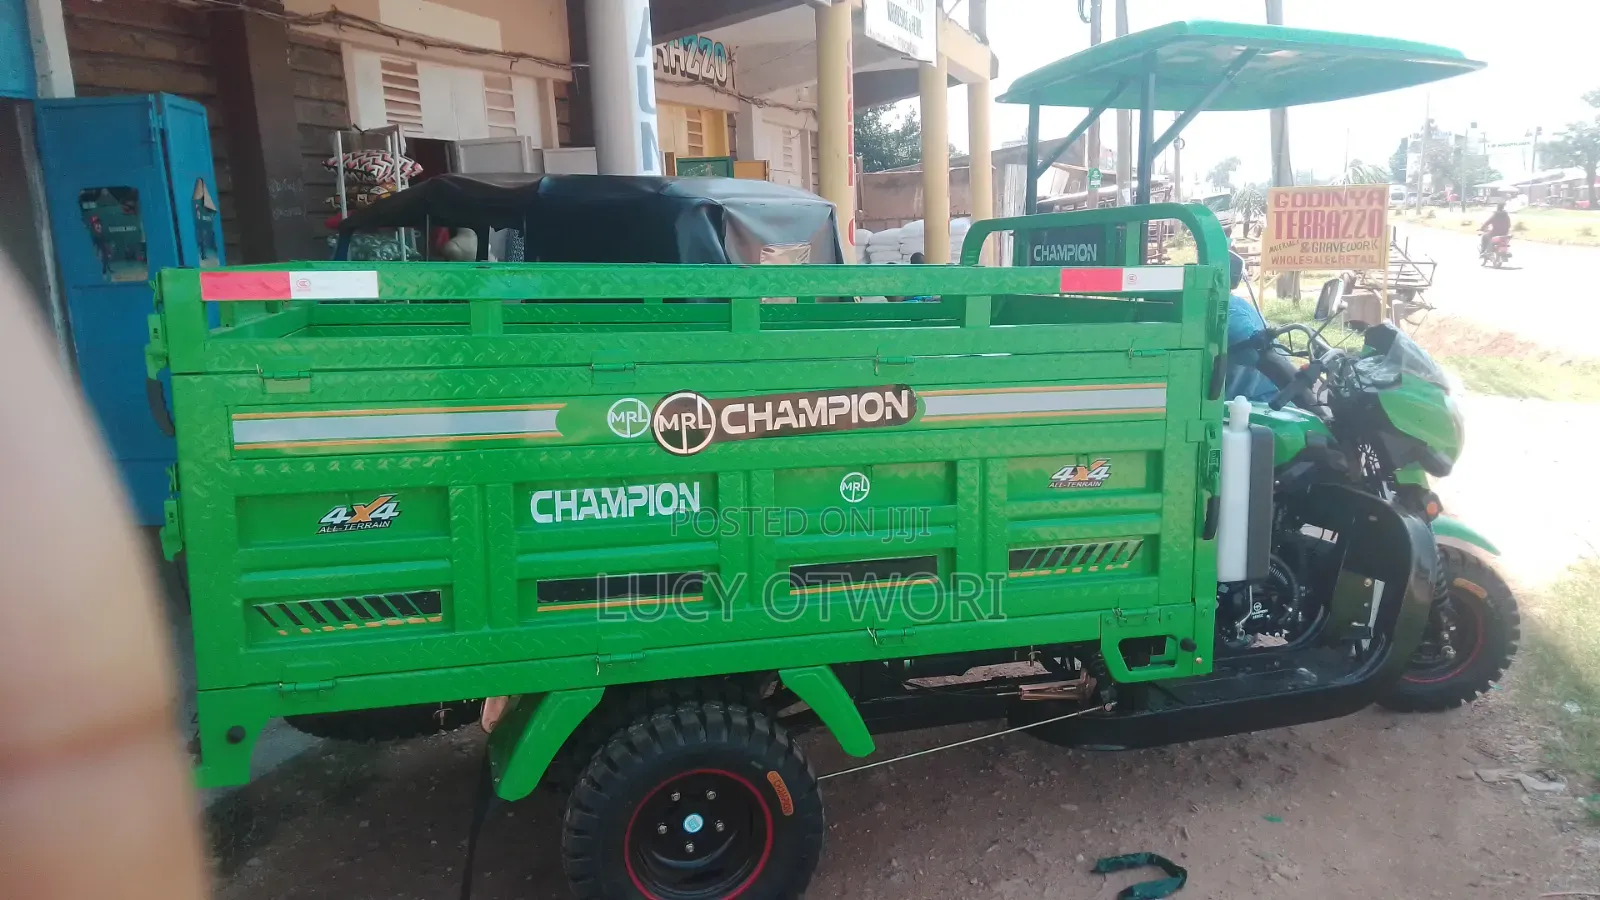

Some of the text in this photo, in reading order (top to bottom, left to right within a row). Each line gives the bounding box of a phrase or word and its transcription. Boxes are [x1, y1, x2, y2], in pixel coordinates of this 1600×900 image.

[1274, 189, 1386, 208] GODINYA
[1273, 209, 1383, 240] TERRAZZO
[1033, 244, 1097, 261] CHAMPION
[609, 399, 649, 438] MRL
[656, 389, 909, 454] MRL CHAMPION
[841, 473, 870, 501] MRL
[1048, 480, 1103, 488] ALL-TERRAIN
[530, 482, 700, 524] CHAMPION
[318, 520, 391, 533] ALL-TERRAIN
